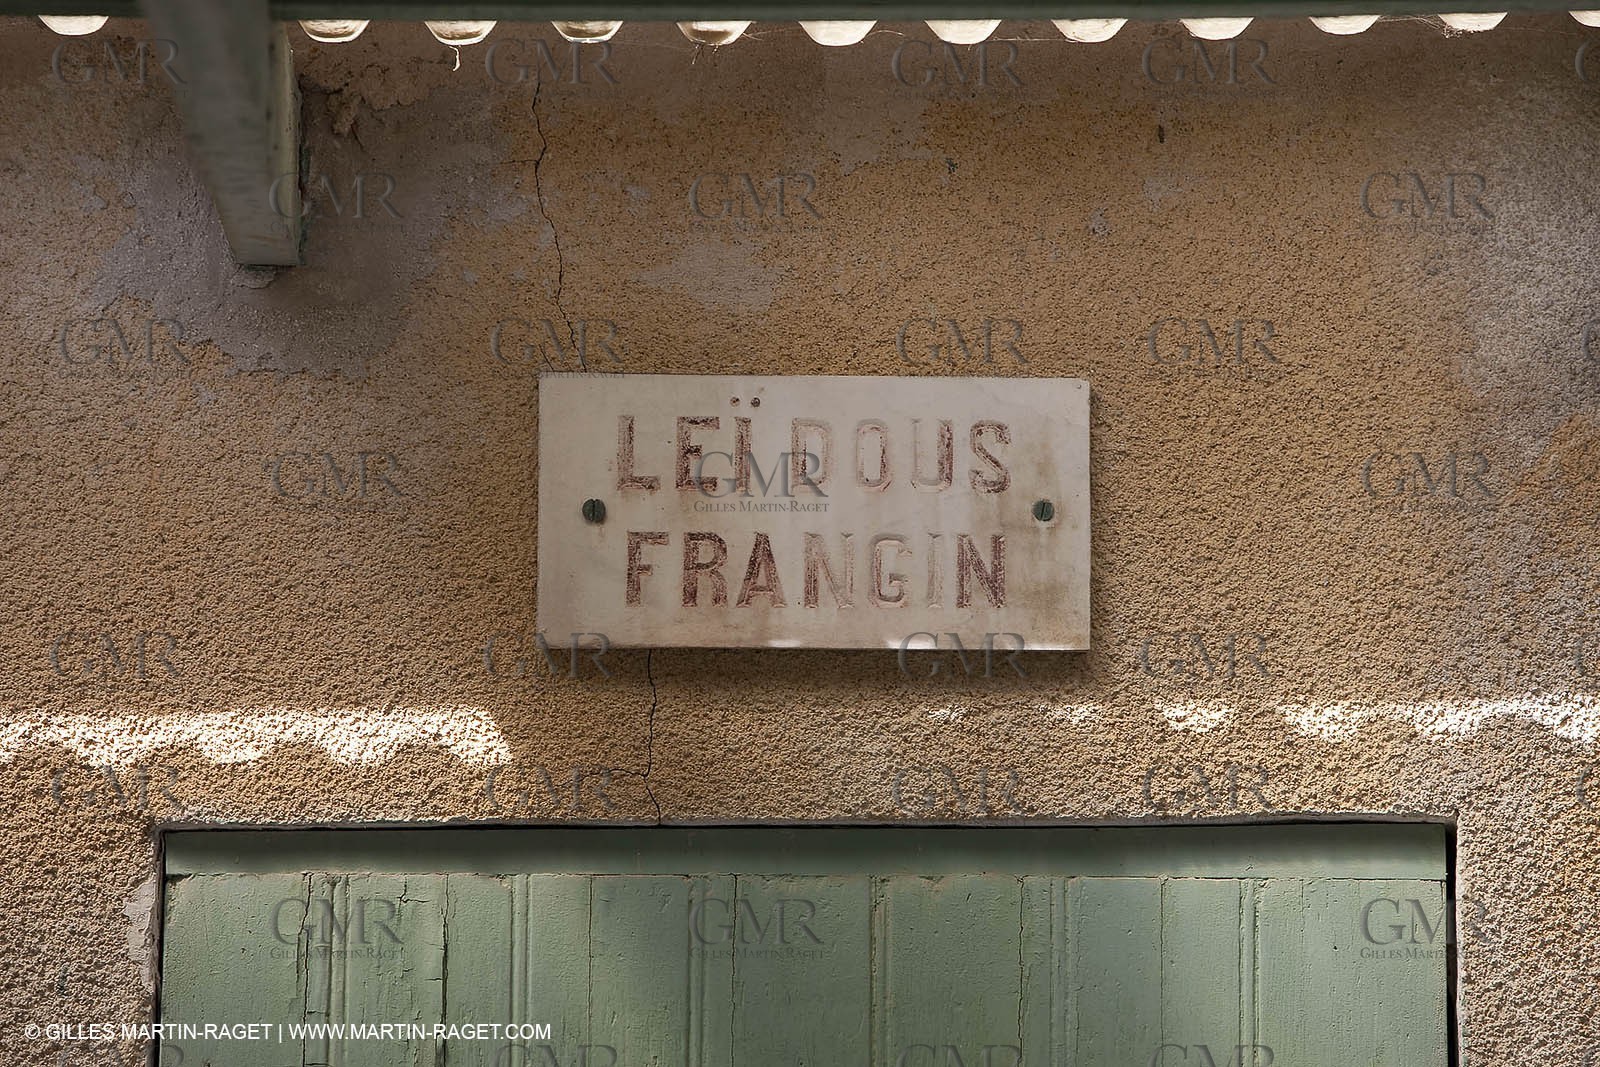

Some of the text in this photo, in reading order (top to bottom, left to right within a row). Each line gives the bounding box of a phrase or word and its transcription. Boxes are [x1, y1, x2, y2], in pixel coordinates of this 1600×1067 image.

[617, 396, 1012, 496] LEÏ DOUS
[625, 530, 1008, 609] FRANGIN
